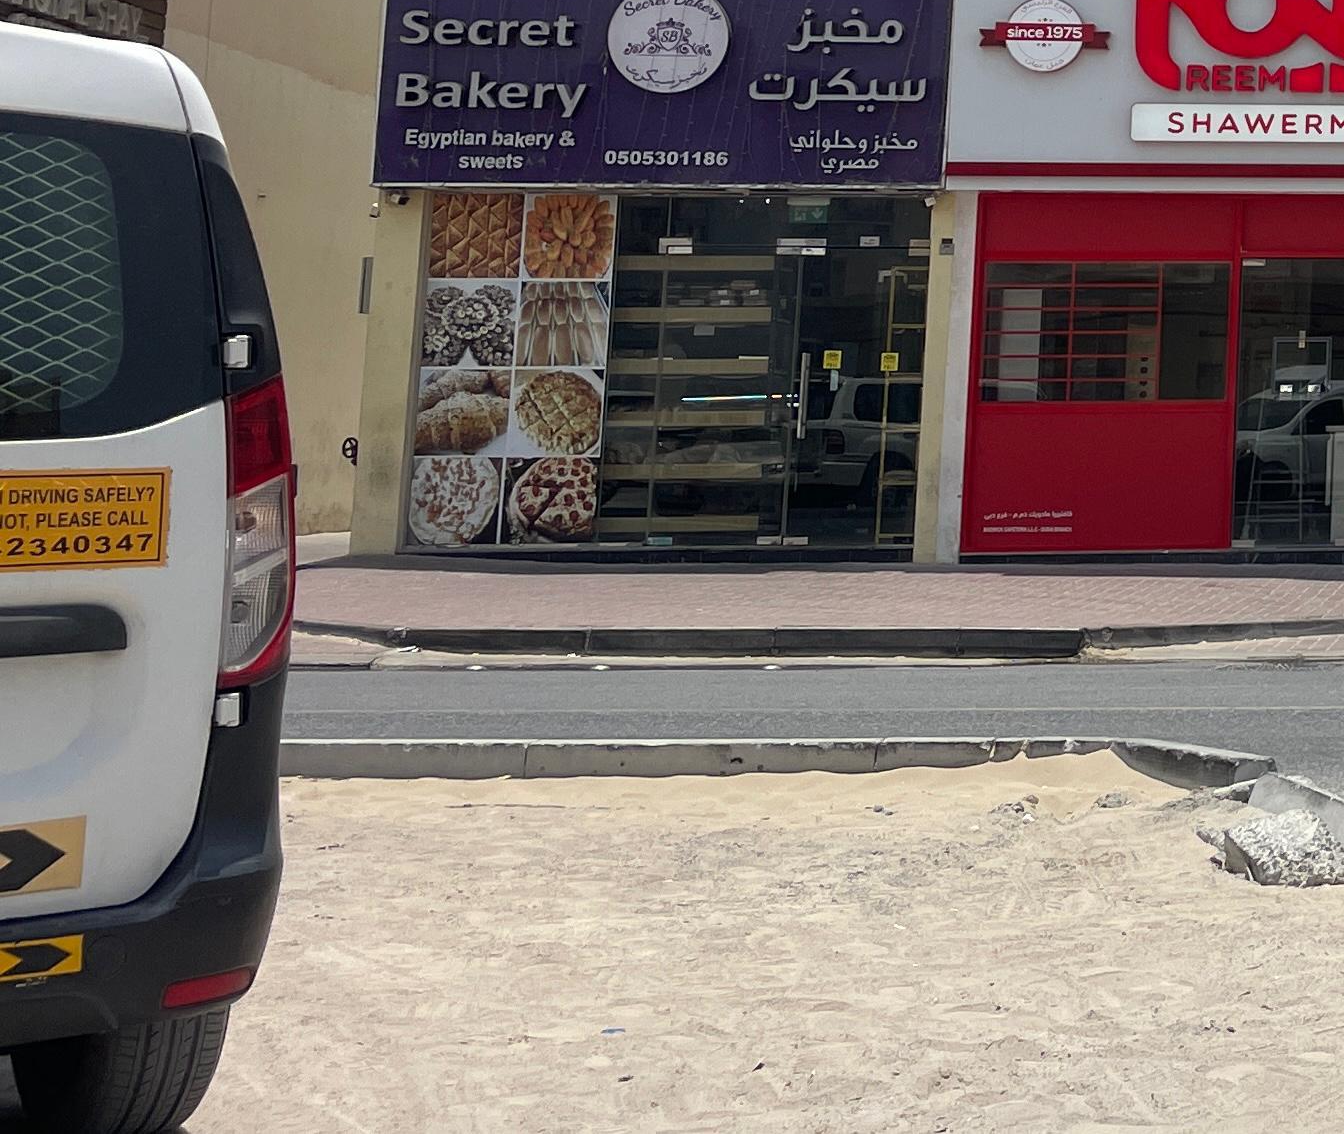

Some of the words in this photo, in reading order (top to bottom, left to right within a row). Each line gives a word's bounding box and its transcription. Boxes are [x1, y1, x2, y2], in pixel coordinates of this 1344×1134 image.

[399, 9, 575, 48] Secret
[660, 29, 679, 43] SB
[785, 7, 905, 57] مخبز
[1006, 25, 1045, 39] since
[1046, 26, 1083, 40] 1975
[747, 65, 929, 114] سيكرت
[1185, 65, 1288, 93] REEM
[393, 71, 587, 119] Bakery
[404, 129, 488, 150] Egyptian
[491, 130, 554, 150] bakery
[558, 130, 576, 148] &
[788, 128, 869, 153] وحلواني
[869, 128, 920, 152] مخبز
[458, 152, 524, 170] sweets
[604, 149, 730, 168] 0505301186
[818, 153, 880, 175] مصري
[8, 487, 79, 505] DRIVING
[83, 485, 156, 504] SAFELY?
[35, 511, 103, 528] PLEASE
[106, 510, 150, 527] CALL
[0, 533, 154, 557] 2340347
